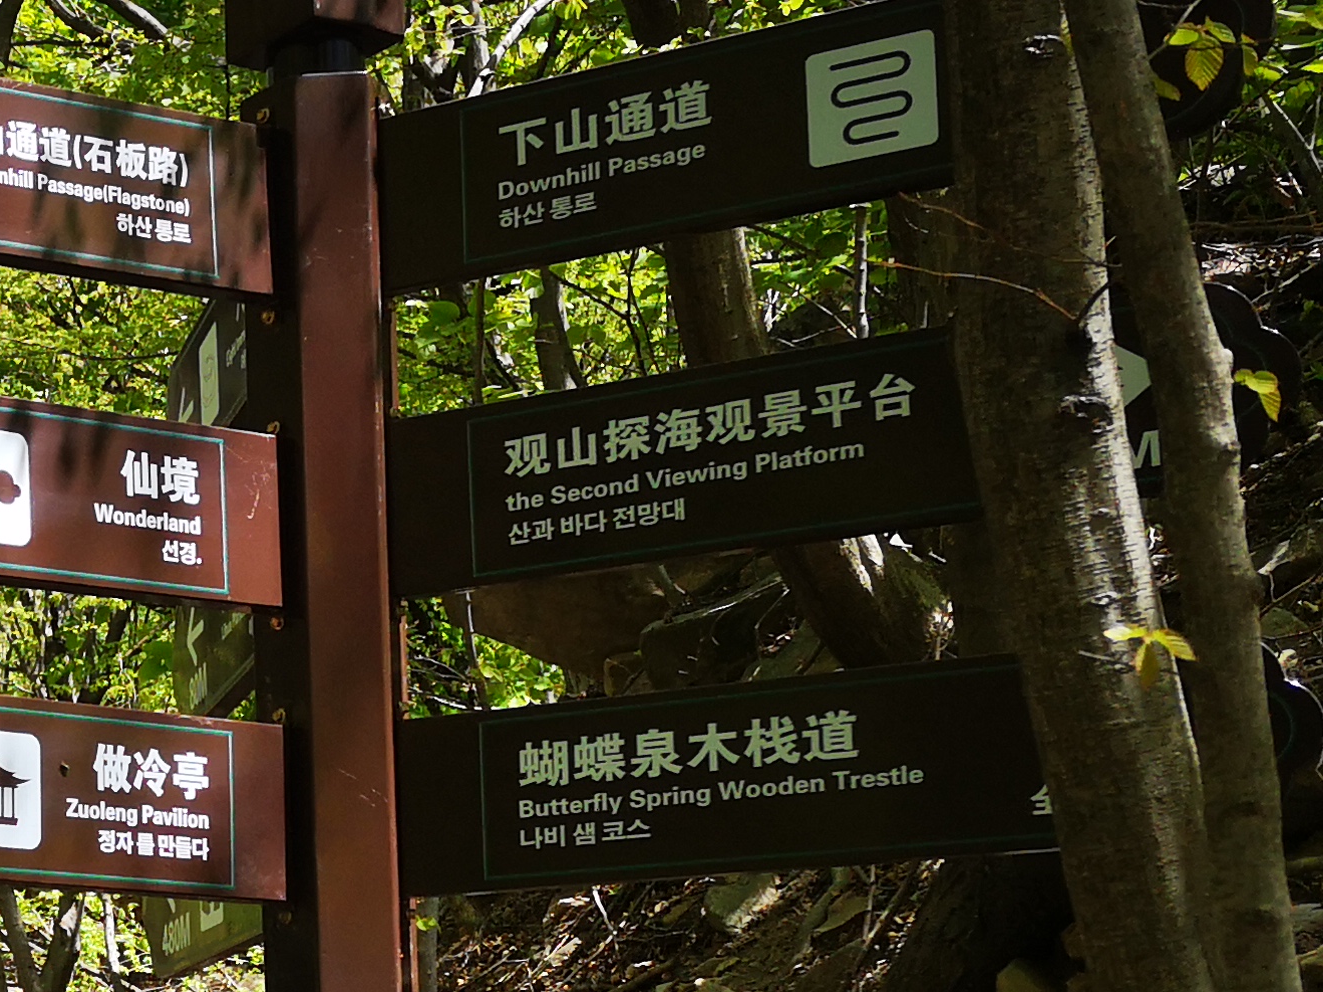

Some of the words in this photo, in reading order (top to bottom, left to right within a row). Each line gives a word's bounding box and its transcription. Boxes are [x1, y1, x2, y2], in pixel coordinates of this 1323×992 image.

[498, 80, 713, 166] 下山通道
[38, 174, 190, 217] Passage(Flagstone)
[498, 161, 601, 200] Downhill
[608, 144, 705, 177] Passage
[116, 213, 151, 238] 하산
[154, 218, 191, 244] 통로
[498, 201, 545, 228] 하산
[549, 192, 597, 220] 통로
[504, 374, 916, 478] 观山探海观景平台
[120, 449, 200, 505] 仙境
[505, 492, 543, 512] the
[550, 474, 639, 505] Second
[647, 460, 748, 490] Viewing
[755, 441, 865, 474] Platform
[93, 503, 202, 535] Wonderland
[508, 518, 555, 546] 산과
[560, 510, 608, 538] 바다
[613, 498, 686, 531] 전망대
[93, 743, 210, 800] 做冷亭
[519, 709, 860, 787] 蝴蝶泉木栈道
[66, 798, 138, 827] Zuoleng
[142, 804, 210, 829] Pavilion
[519, 792, 622, 819] Butterfly
[629, 785, 711, 811] Spring
[718, 777, 825, 801] Wooden
[832, 765, 924, 789] Trestle
[519, 824, 566, 849] 나비
[573, 821, 596, 846] 샘
[602, 818, 652, 842] 코스
